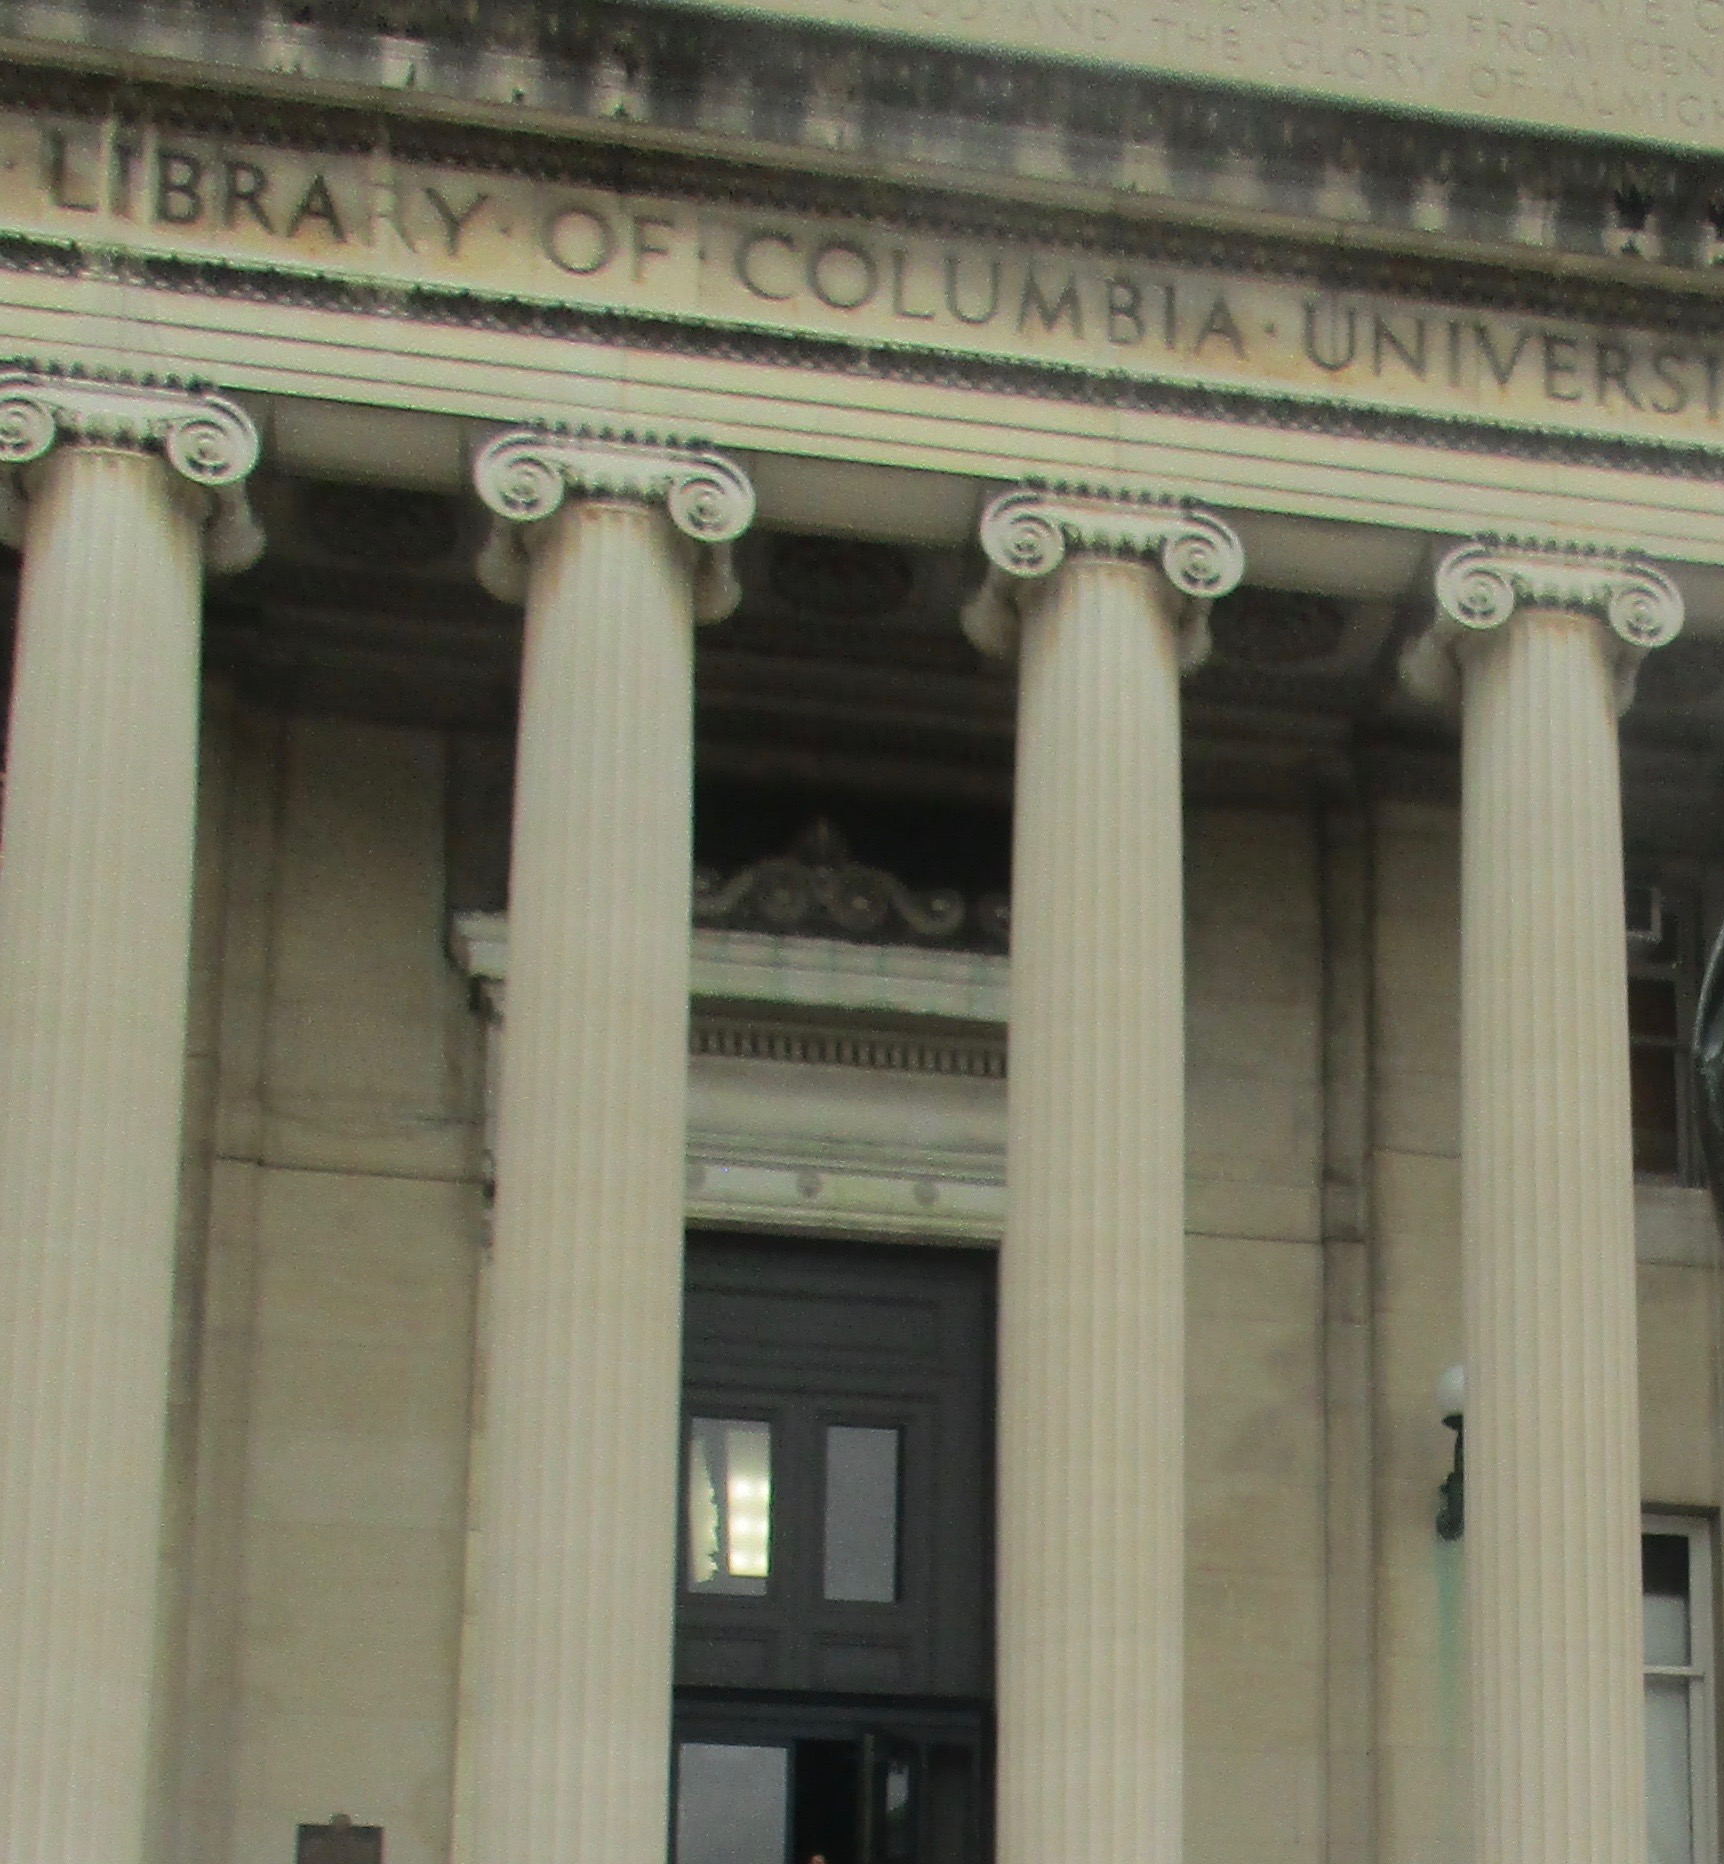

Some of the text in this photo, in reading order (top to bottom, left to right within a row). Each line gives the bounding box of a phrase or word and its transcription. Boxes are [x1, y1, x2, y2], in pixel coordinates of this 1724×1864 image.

[1150, 16, 1241, 62] THE
[1278, 37, 1437, 86] GLORY
[1468, 62, 1528, 100] OF
[1466, 12, 1592, 62] FROM
[46, 125, 489, 259] LIBRARY
[540, 204, 680, 284] OF
[733, 228, 1250, 363] COLUMBIA
